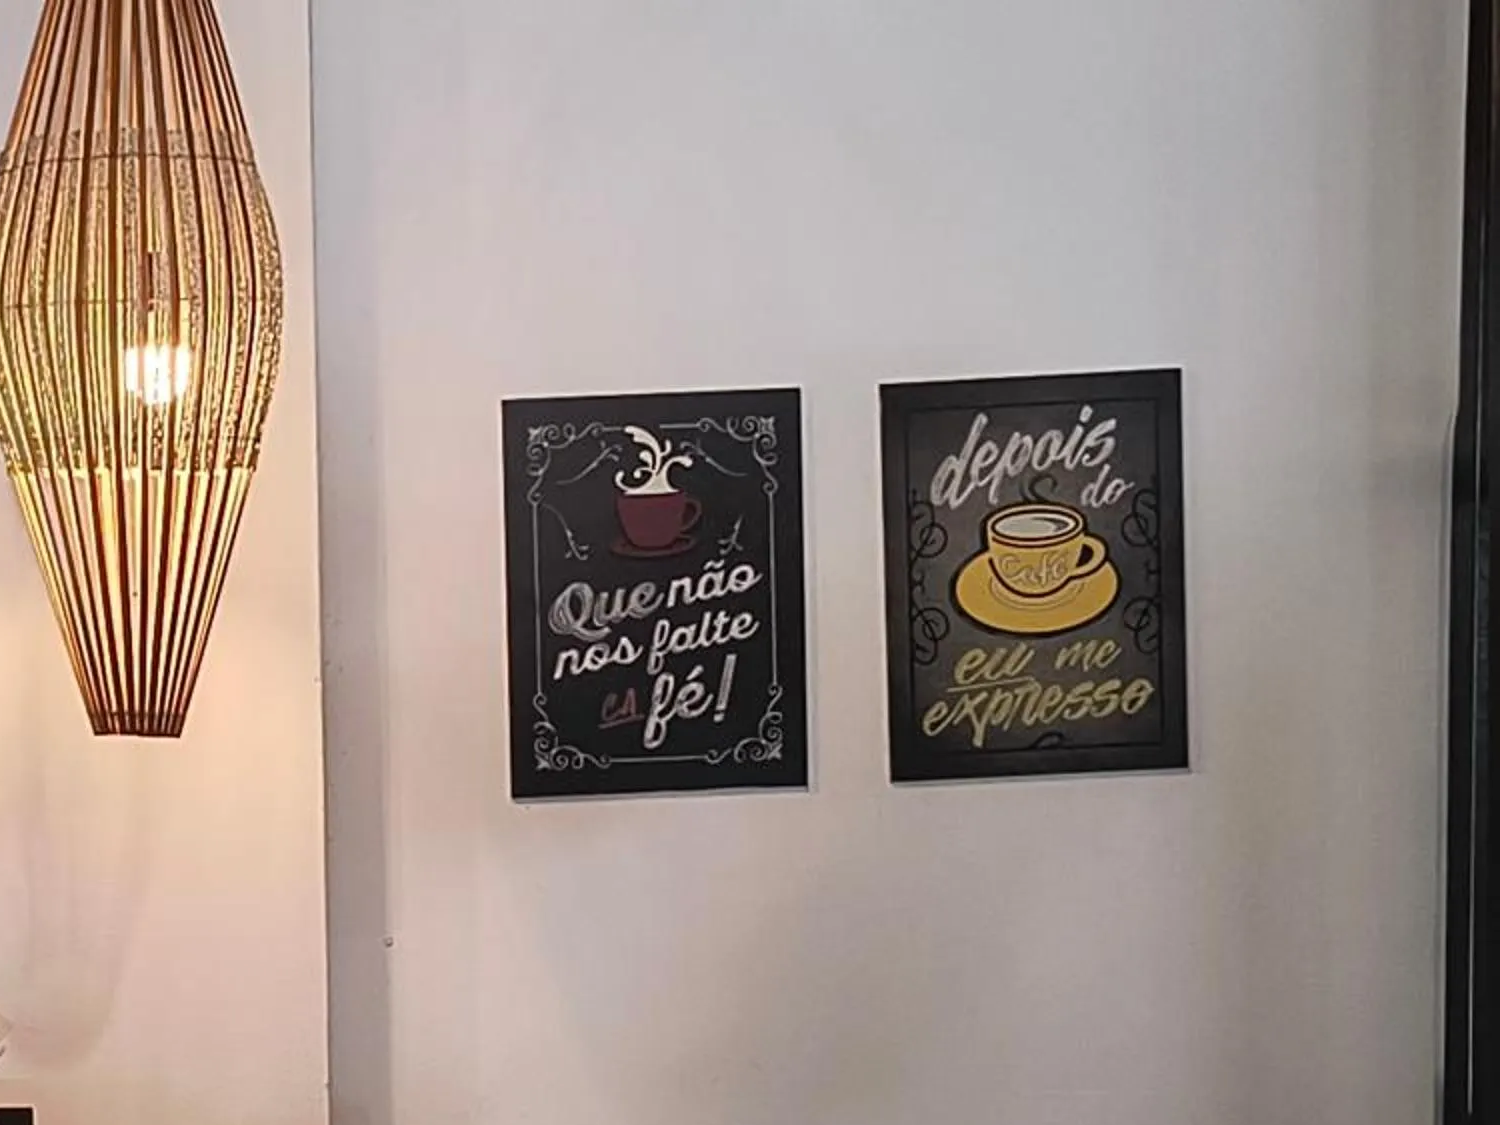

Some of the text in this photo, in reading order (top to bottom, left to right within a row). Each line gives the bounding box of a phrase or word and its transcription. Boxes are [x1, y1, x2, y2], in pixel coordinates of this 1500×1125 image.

[931, 405, 1117, 509] depois
[1081, 464, 1135, 509] do
[548, 559, 764, 641] Que não
[553, 610, 760, 680] nos falte
[952, 639, 1122, 684] eu me
[643, 653, 737, 750] fé!
[922, 677, 1156, 749] expresso
